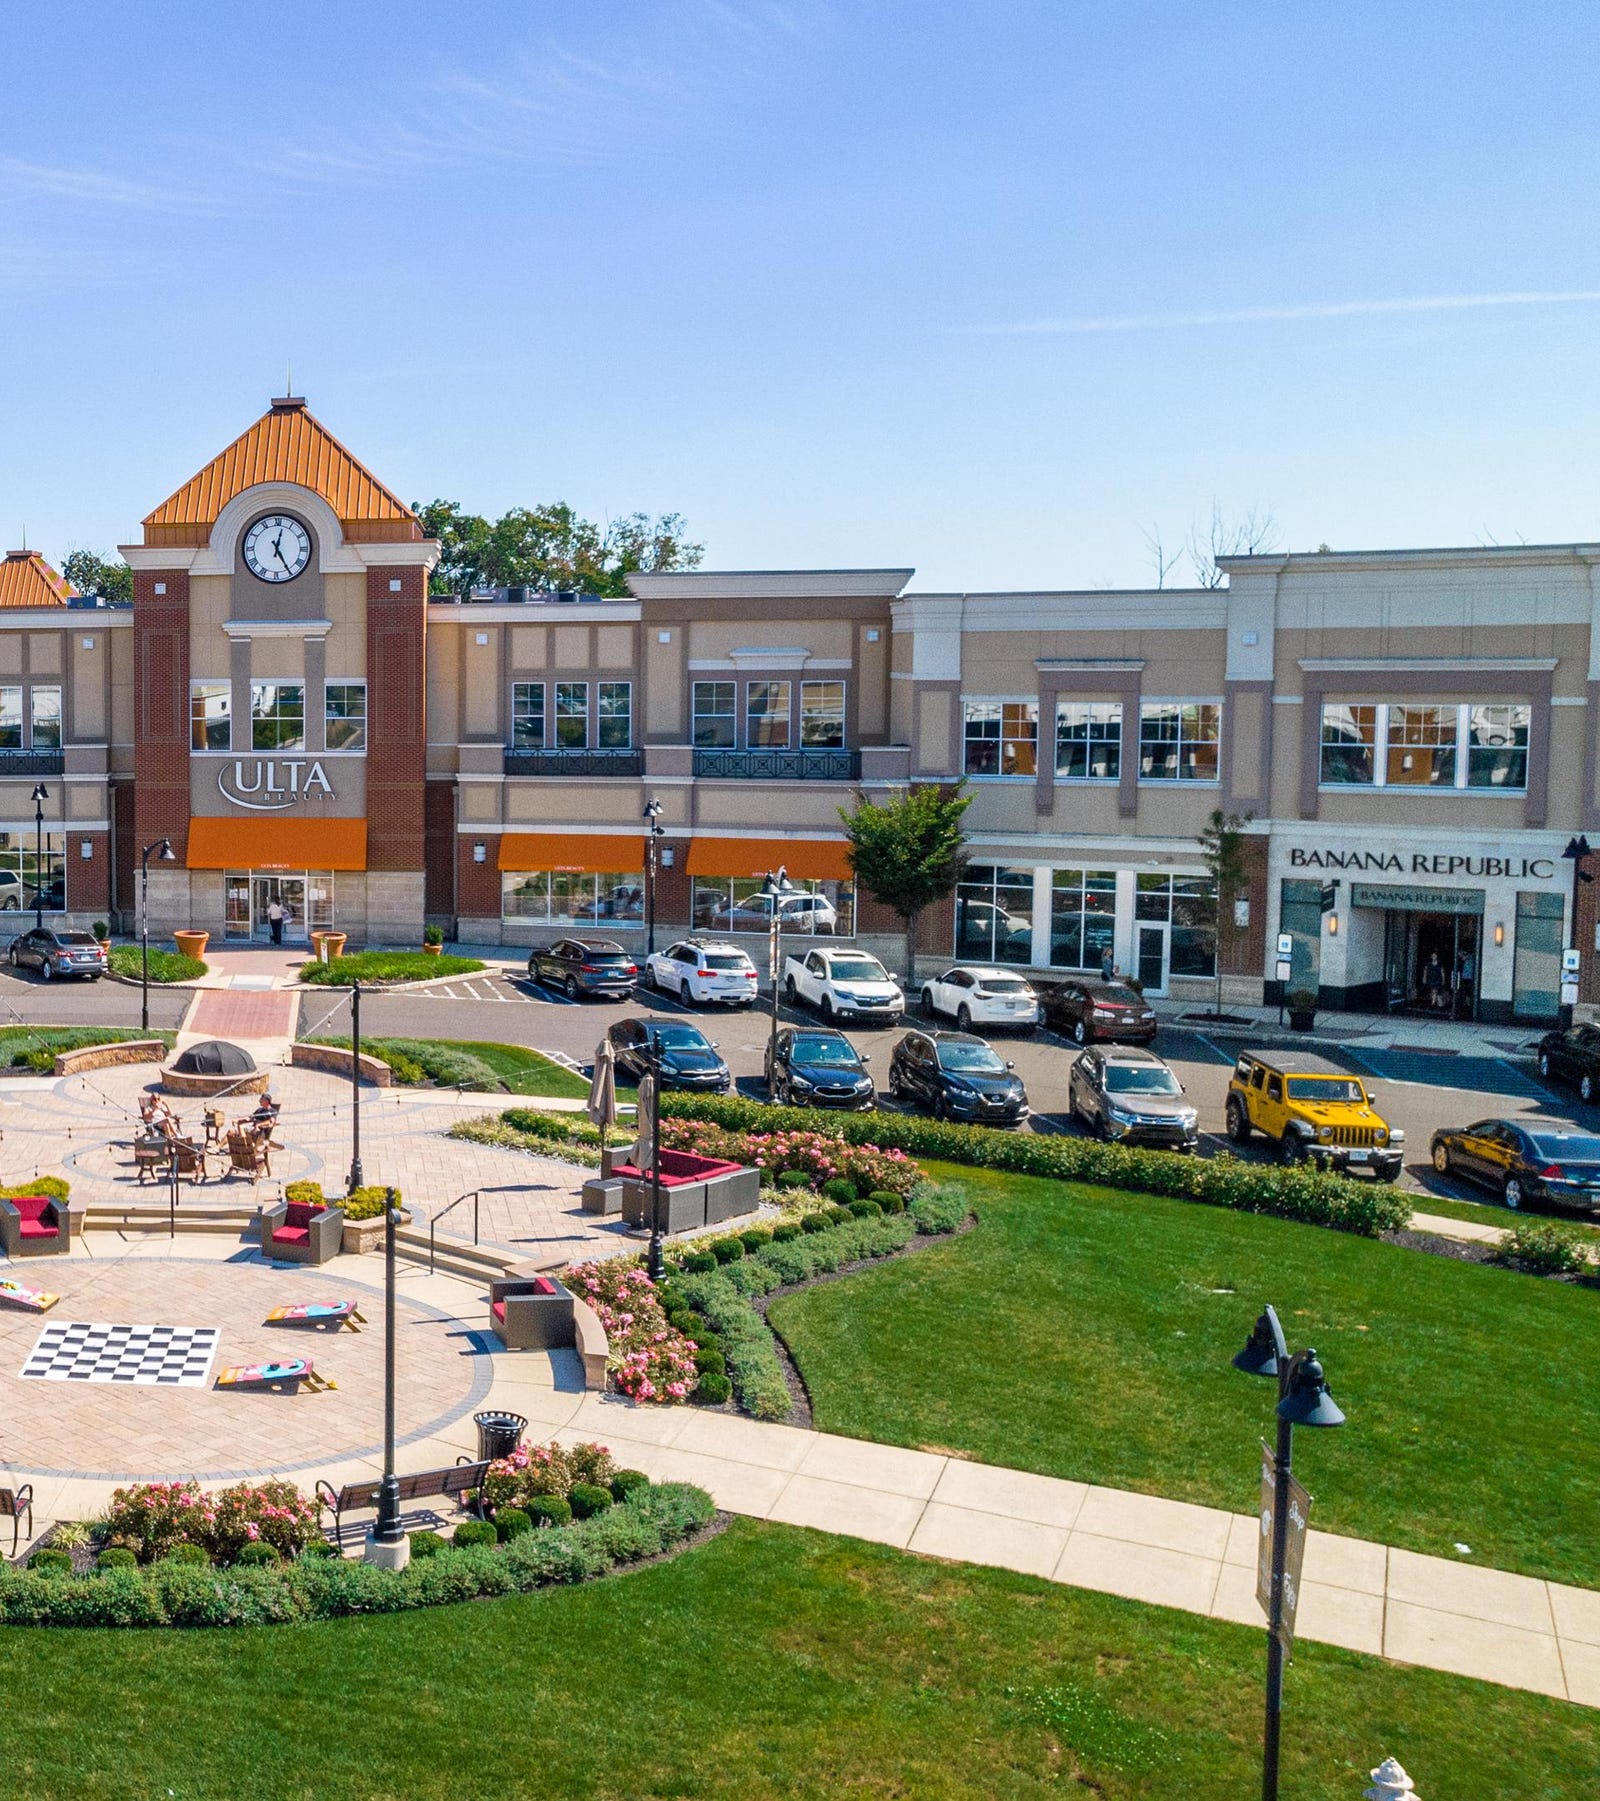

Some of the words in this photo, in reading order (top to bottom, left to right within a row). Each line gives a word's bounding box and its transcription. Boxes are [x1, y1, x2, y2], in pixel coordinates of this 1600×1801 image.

[235, 761, 332, 792] ULTA
[264, 793, 338, 801] BEAUTY
[1290, 848, 1404, 872] BANANA
[1412, 854, 1554, 879] REPUBLIC
[1361, 890, 1413, 902] BANANA
